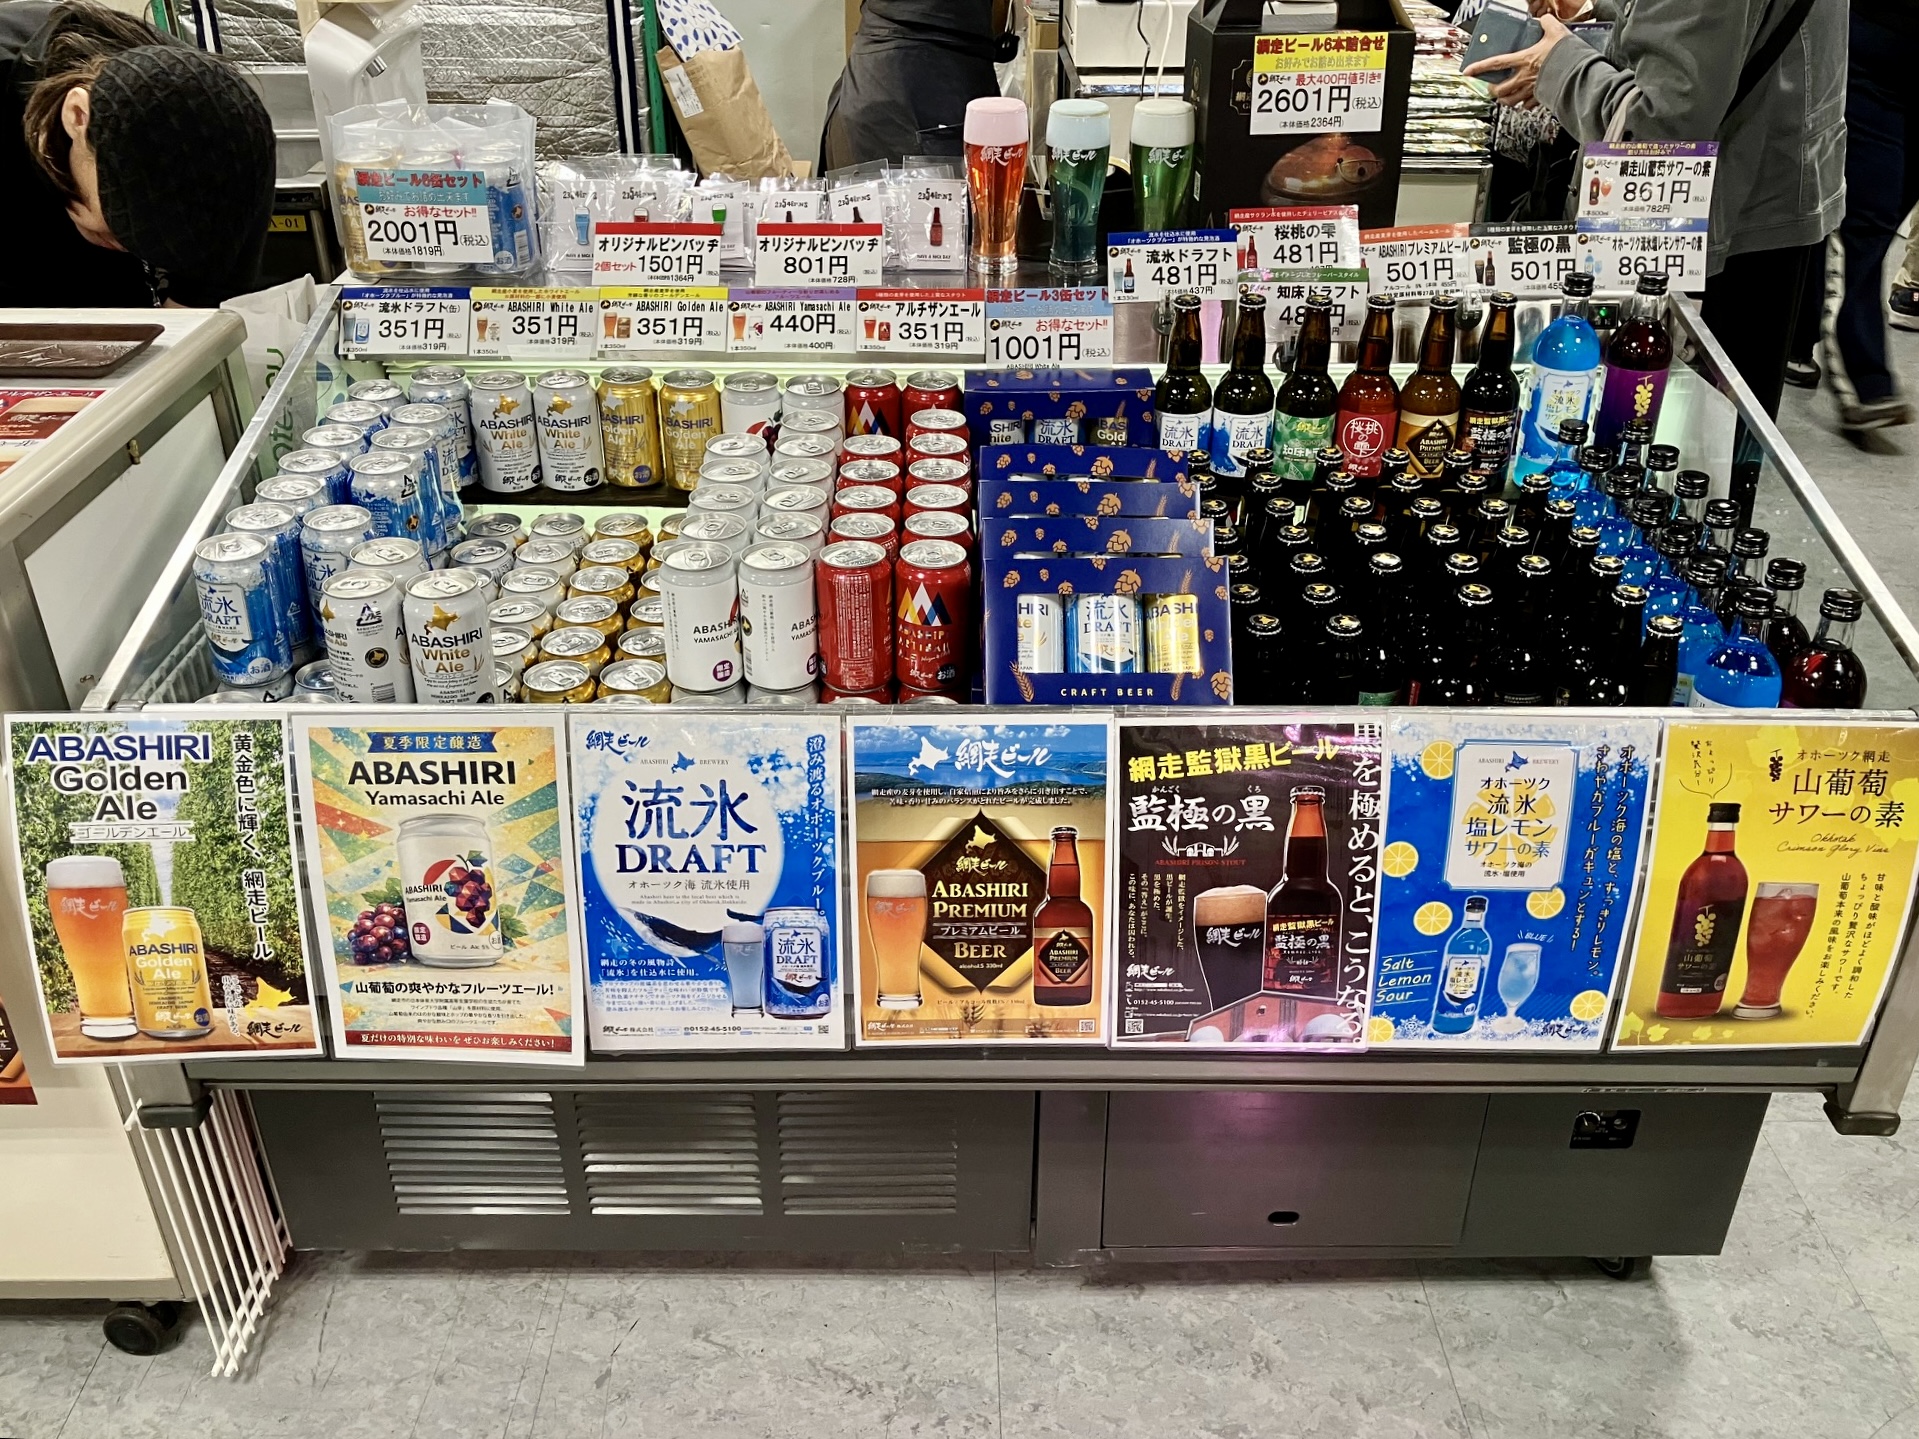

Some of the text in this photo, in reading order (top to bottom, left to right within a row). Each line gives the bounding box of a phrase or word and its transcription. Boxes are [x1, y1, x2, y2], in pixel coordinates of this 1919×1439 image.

[1256, 36, 1386, 54] 網走ビール6本詰合せ
[1257, 87, 1349, 114] 2601円
[1352, 95, 1382, 110] (税込)
[1279, 116, 1344, 129] (本体価格2364円)
[1620, 161, 1711, 177] 網走山葡萄サワーの素
[1623, 180, 1691, 204] 861円
[404, 205, 477, 219] お得なセット!!
[368, 220, 490, 246] 2001円 (税込)
[1274, 224, 1336, 240] 桜桃の雫
[382, 246, 446, 257] (本体価格1819円)
[598, 236, 719, 253] オリジナルピンバッヂ
[759, 238, 878, 253] オリジナルピンバッヂ
[1379, 240, 1469, 258] ABASHIRIプレミアムビール
[1508, 236, 1571, 253] 監極の黒
[1146, 249, 1233, 264] 流氷ドラフト
[1273, 242, 1338, 264] 481円
[594, 256, 703, 275] 2個セット 1501円
[783, 257, 849, 275] 801円
[1387, 258, 1454, 282] 501円
[1511, 260, 1576, 282] 501円
[1618, 255, 1685, 276] 861円
[1151, 265, 1217, 285] 481円
[1277, 285, 1360, 300] 知床ドラフト
[379, 302, 461, 314] 流氷ドラフト(缶)
[508, 302, 594, 313] ABASHIRI White Ale
[636, 301, 724, 313] ABASHIRI Golden Ale
[765, 301, 850, 313] ABASHIRI Yamasachi Ale
[896, 303, 980, 318] アルチザンエール
[378, 319, 446, 339] 351円
[511, 315, 578, 336] 351円
[637, 317, 703, 336] 351円
[770, 314, 836, 335] 440円
[898, 322, 964, 342] 351円
[1036, 319, 1108, 332] お得なセット!!
[990, 335, 1110, 361] 1001円 (税込)
[480, 414, 533, 429] ABASHIRI
[537, 415, 591, 428] ABASHIRI
[1041, 419, 1073, 436] 流氷
[491, 428, 527, 440] White
[545, 429, 580, 439] White
[666, 428, 706, 439] Golden
[1164, 424, 1193, 439] 流氷
[1236, 425, 1263, 440] 流氷
[501, 439, 523, 450] Ale
[554, 439, 576, 449] Ale
[674, 438, 696, 449] Ale
[1162, 439, 1194, 448] DRAFT
[1232, 439, 1264, 448] DRAFT
[1018, 603, 1049, 616] HIRI
[1086, 601, 1127, 620] 流氷
[1084, 622, 1131, 634] DRAFT
[411, 627, 483, 648] ABASHIRI
[422, 648, 470, 660] White
[250, 664, 271, 675] お酒
[435, 662, 464, 673] Ale
[1061, 688, 1154, 697] CRAFT BEER
[27, 734, 211, 762] ABASHIRI
[383, 735, 483, 750] 夏季限定醸造
[585, 730, 650, 755] 網走ビール
[955, 738, 1053, 778] 網走ビール
[1128, 738, 1339, 783] 網走監獄黒ビール
[1797, 749, 1891, 763] オホーツク網走
[53, 765, 187, 792] Golden
[348, 760, 516, 785] ABASHIRI
[1481, 777, 1551, 790] オホーツク
[1793, 768, 1889, 797] 山葡萄
[365, 790, 504, 806] Yamasachi Ale
[1488, 793, 1536, 815] 流氷
[95, 795, 158, 821] Ale
[621, 779, 759, 840] 流氷
[1128, 794, 1275, 832] 監極の黒
[1768, 801, 1905, 828] サワーの素
[77, 826, 187, 839] ゴールデンエール
[1467, 817, 1552, 837] 塩レモン
[233, 733, 273, 960] 黄金色に輝く、網走ビール
[1465, 841, 1551, 858] サワーの素
[616, 844, 767, 873] DRAFT
[955, 856, 1008, 873] 網走ビール
[1480, 861, 1532, 869] オホーツク海の
[405, 884, 443, 894] ABASHIRI
[628, 879, 750, 890] オホーツク海 流氷使用
[931, 880, 1029, 898] ABASHIRI
[933, 902, 1027, 918] PREMIUM
[941, 926, 1020, 935] プレミアムビール
[1205, 927, 1262, 947] 網走ビール
[1524, 932, 1547, 942] BLUE
[778, 938, 815, 955] 流氷
[1274, 934, 1332, 949] 監極の黒
[129, 944, 198, 957] ABASHIRI
[954, 942, 1007, 958] BEER
[136, 956, 193, 968] Golden
[600, 958, 674, 967] 網走の冬の風物詩
[776, 955, 818, 965] DRAFT
[1382, 958, 1414, 971] Salt
[153, 968, 182, 980] Ale
[1378, 973, 1432, 988] Lemon
[355, 982, 554, 996] 山葡萄の爽やかなフルーツエール!
[1375, 990, 1414, 1004] Sour
[361, 1033, 555, 1048] 夏だけの特別な味わいを ぜひお楽しみください!
